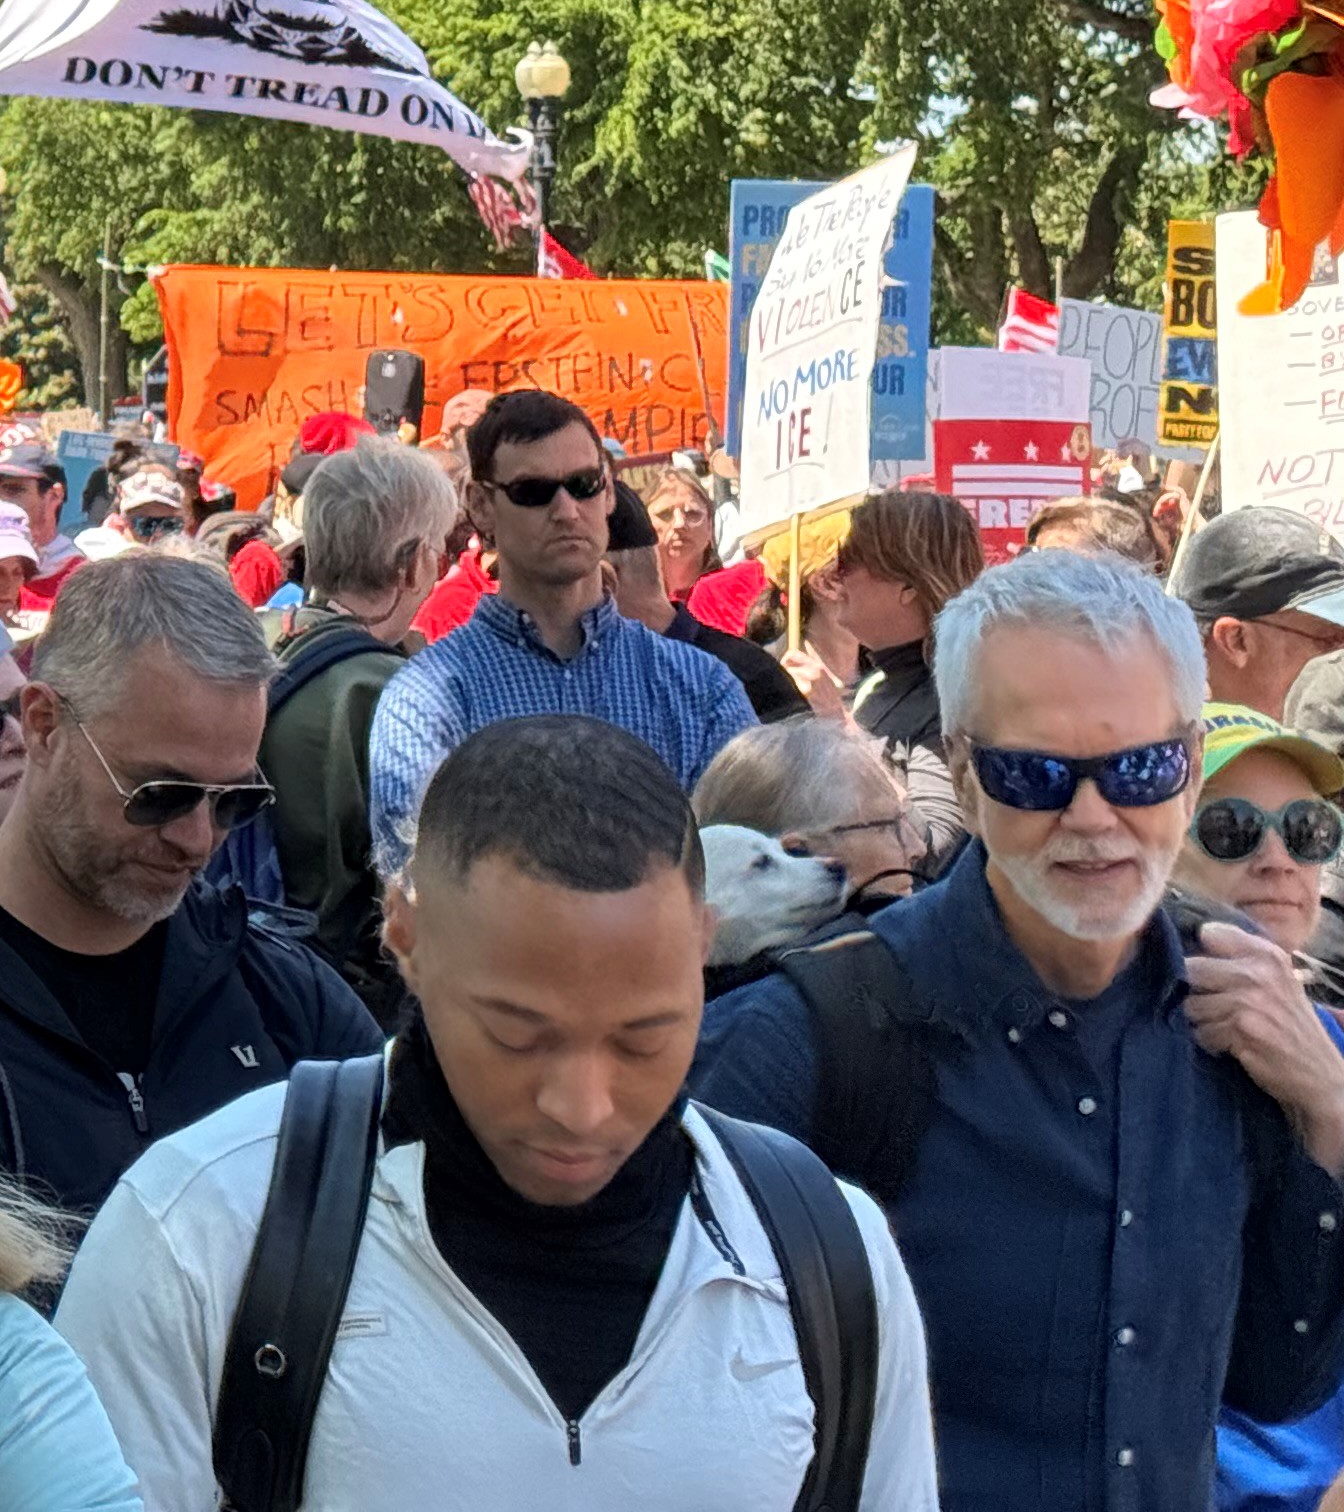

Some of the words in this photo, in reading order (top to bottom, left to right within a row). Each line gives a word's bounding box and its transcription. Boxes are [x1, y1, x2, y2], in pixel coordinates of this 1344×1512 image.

[61, 55, 216, 94] DON'T
[225, 73, 390, 118] TREAD
[400, 93, 455, 132] ON
[216, 279, 455, 358] LET'S
[758, 259, 866, 354] VIOLENCE
[1058, 305, 1162, 385] PEOPL
[215, 379, 348, 427] SMASH
[757, 377, 790, 428] NO
[792, 348, 862, 403] MORE
[775, 406, 813, 471] ICE
